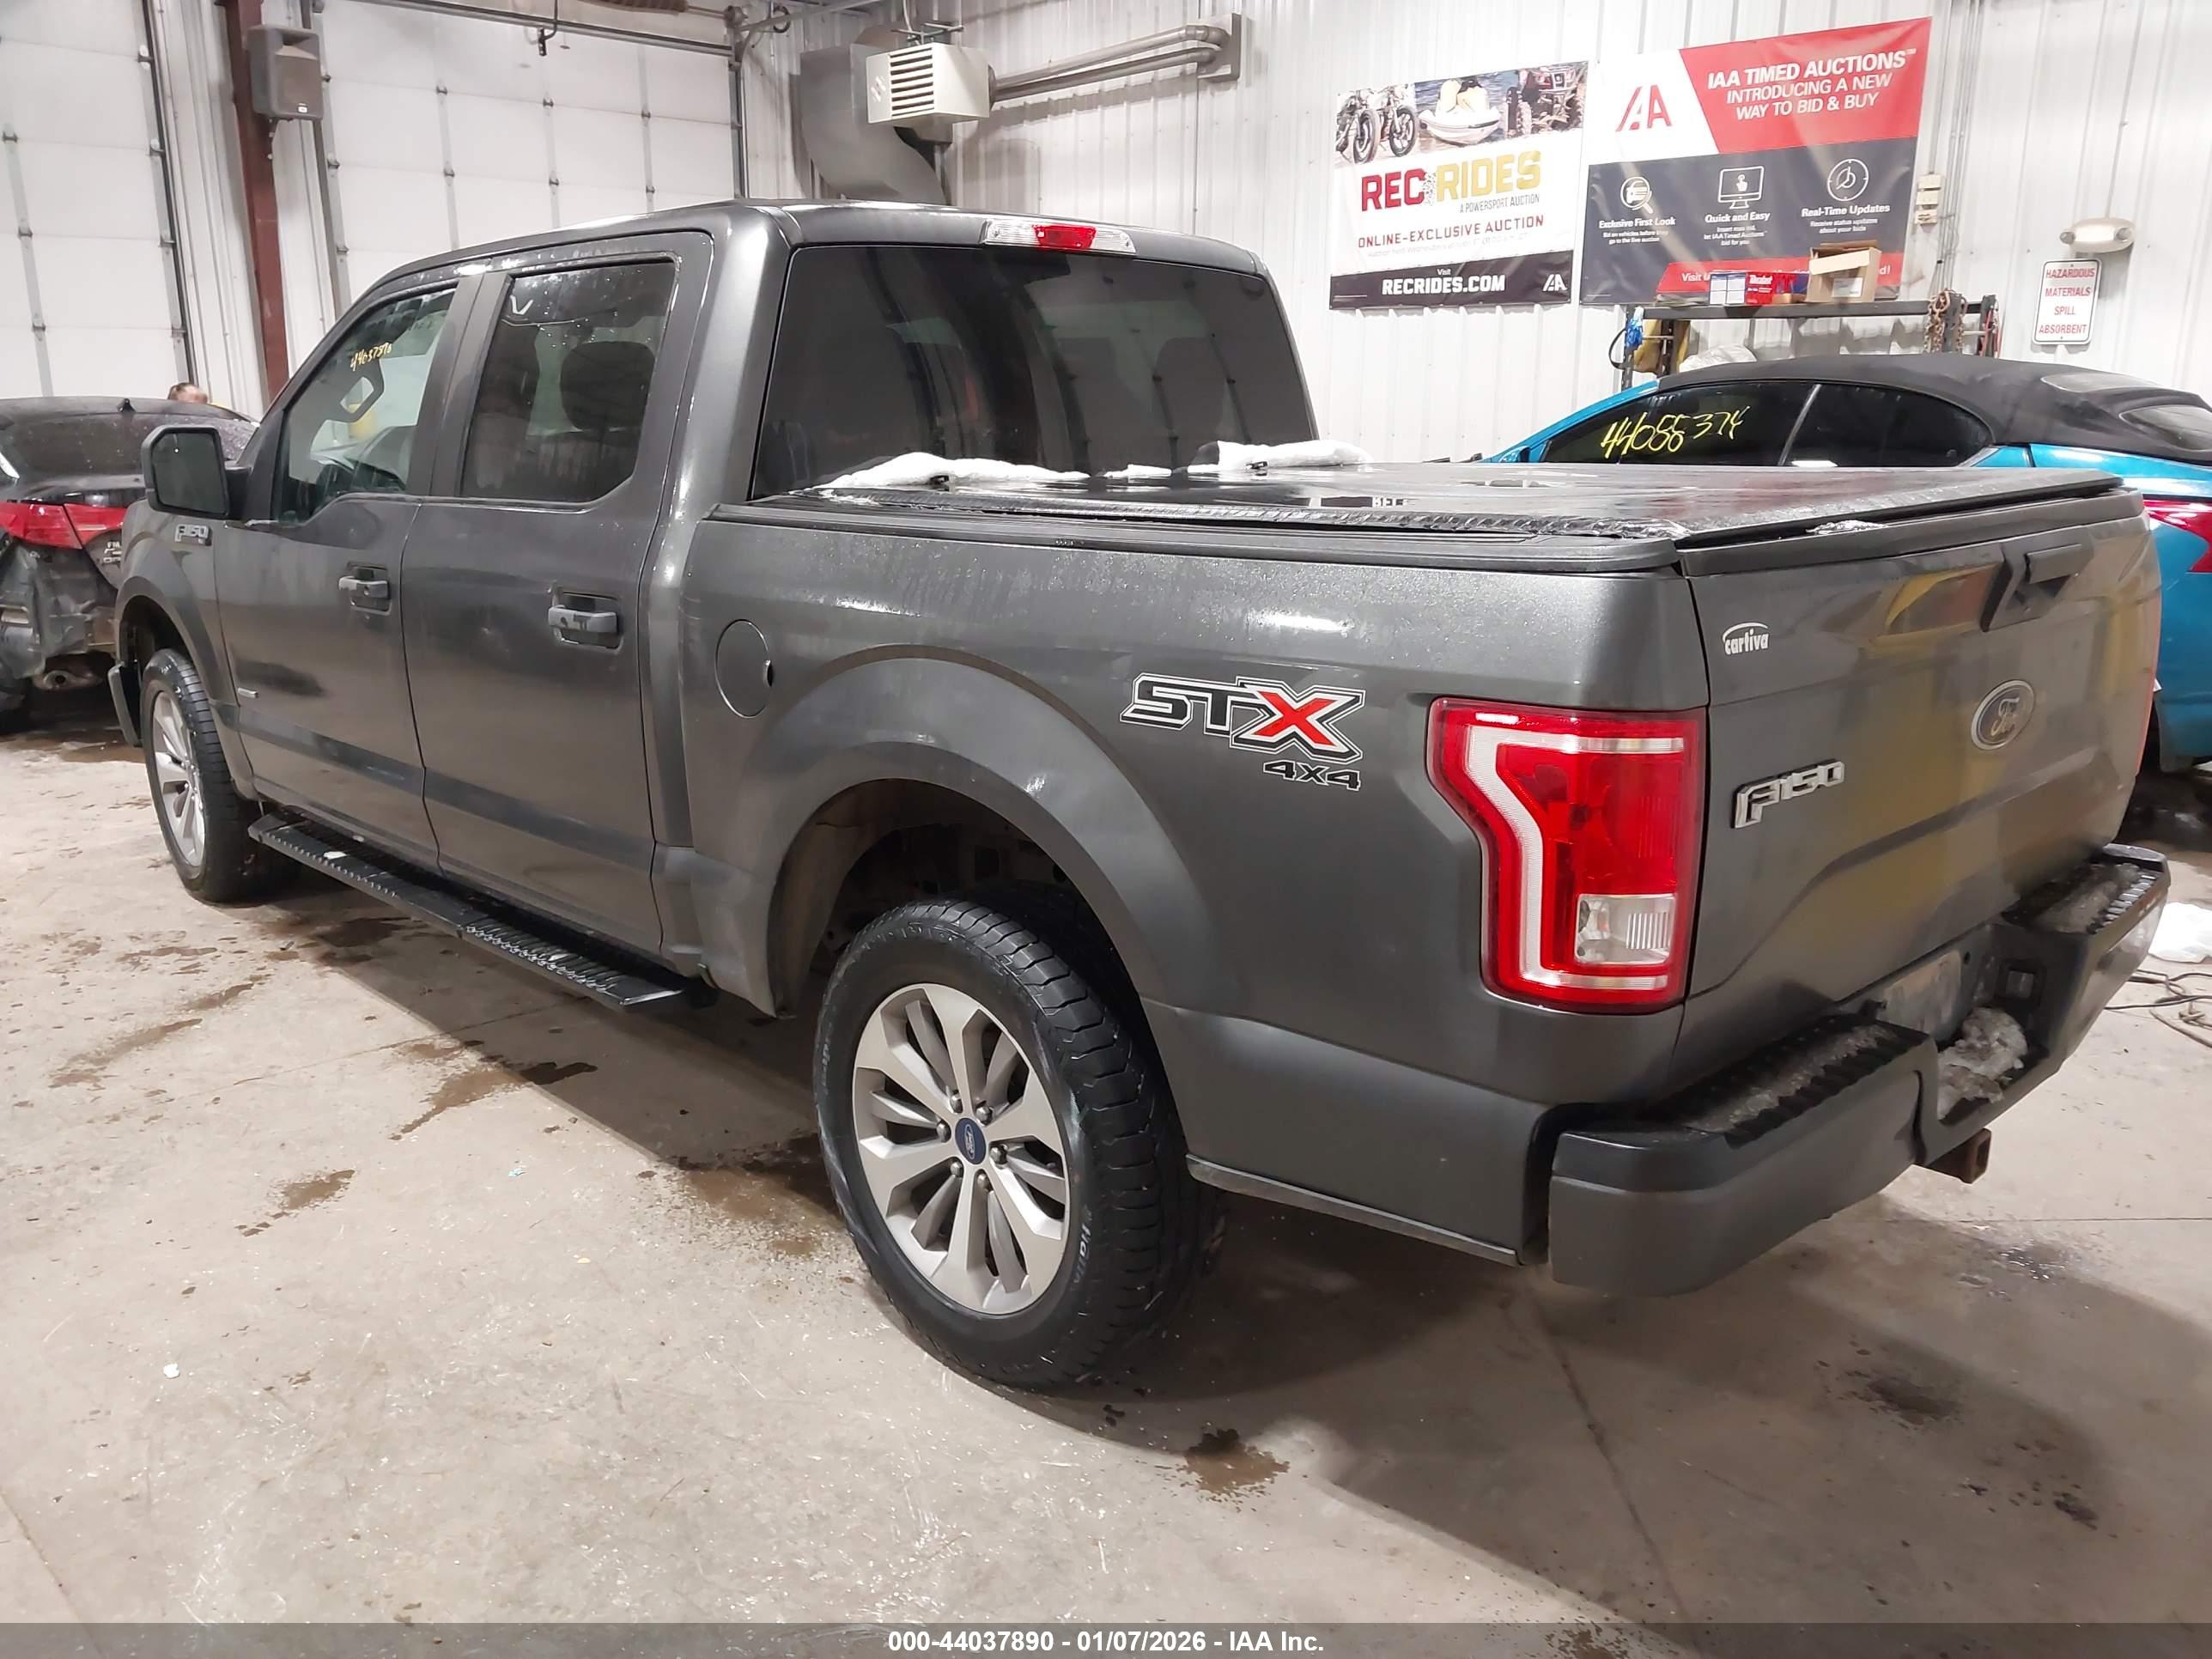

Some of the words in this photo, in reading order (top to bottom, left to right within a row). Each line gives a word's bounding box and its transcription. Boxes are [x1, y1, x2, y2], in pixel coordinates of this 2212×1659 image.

[1708, 70, 1740, 89] IAA
[1745, 63, 1800, 85] TIMED
[1727, 79, 1832, 104] INTRODUCING
[1835, 78, 1849, 93] A
[1852, 72, 1893, 89] NEW
[1736, 104, 1769, 120] WAY
[1772, 101, 1793, 116] TO
[1797, 97, 1824, 113] BID
[1827, 96, 1839, 111] &
[1844, 92, 1880, 110] BUY
[1361, 168, 1427, 212] REC
[1435, 150, 1541, 203] RIDES
[1460, 202, 1465, 213] A
[1465, 196, 1509, 213] POWERSPORT
[1510, 193, 1540, 207] AUCTION
[1802, 206, 1848, 217] Real-Time
[1849, 204, 1891, 216] Updates
[1599, 218, 1633, 228] Exclusive
[1634, 217, 1653, 227] First
[1654, 216, 1676, 226] Look
[1705, 214, 1731, 223] Quick
[1732, 212, 1748, 222] and
[1750, 211, 1771, 222] Easy
[1358, 222, 1481, 248] ONLINE-EXCLUSIVE
[1485, 215, 1544, 233] AUCTION
[1436, 268, 1451, 276] Visit
[1681, 272, 1702, 282] Visit
[2045, 268, 2095, 278] HAZARDOUS
[1382, 275, 1505, 295] RECRIDES.COM
[2045, 287, 2092, 296] MATERIALS
[2054, 306, 2075, 316] SPILL
[2039, 324, 2087, 334] ABSORBENT
[1724, 628, 1769, 655] cartiva
[1120, 672, 1365, 764] STX
